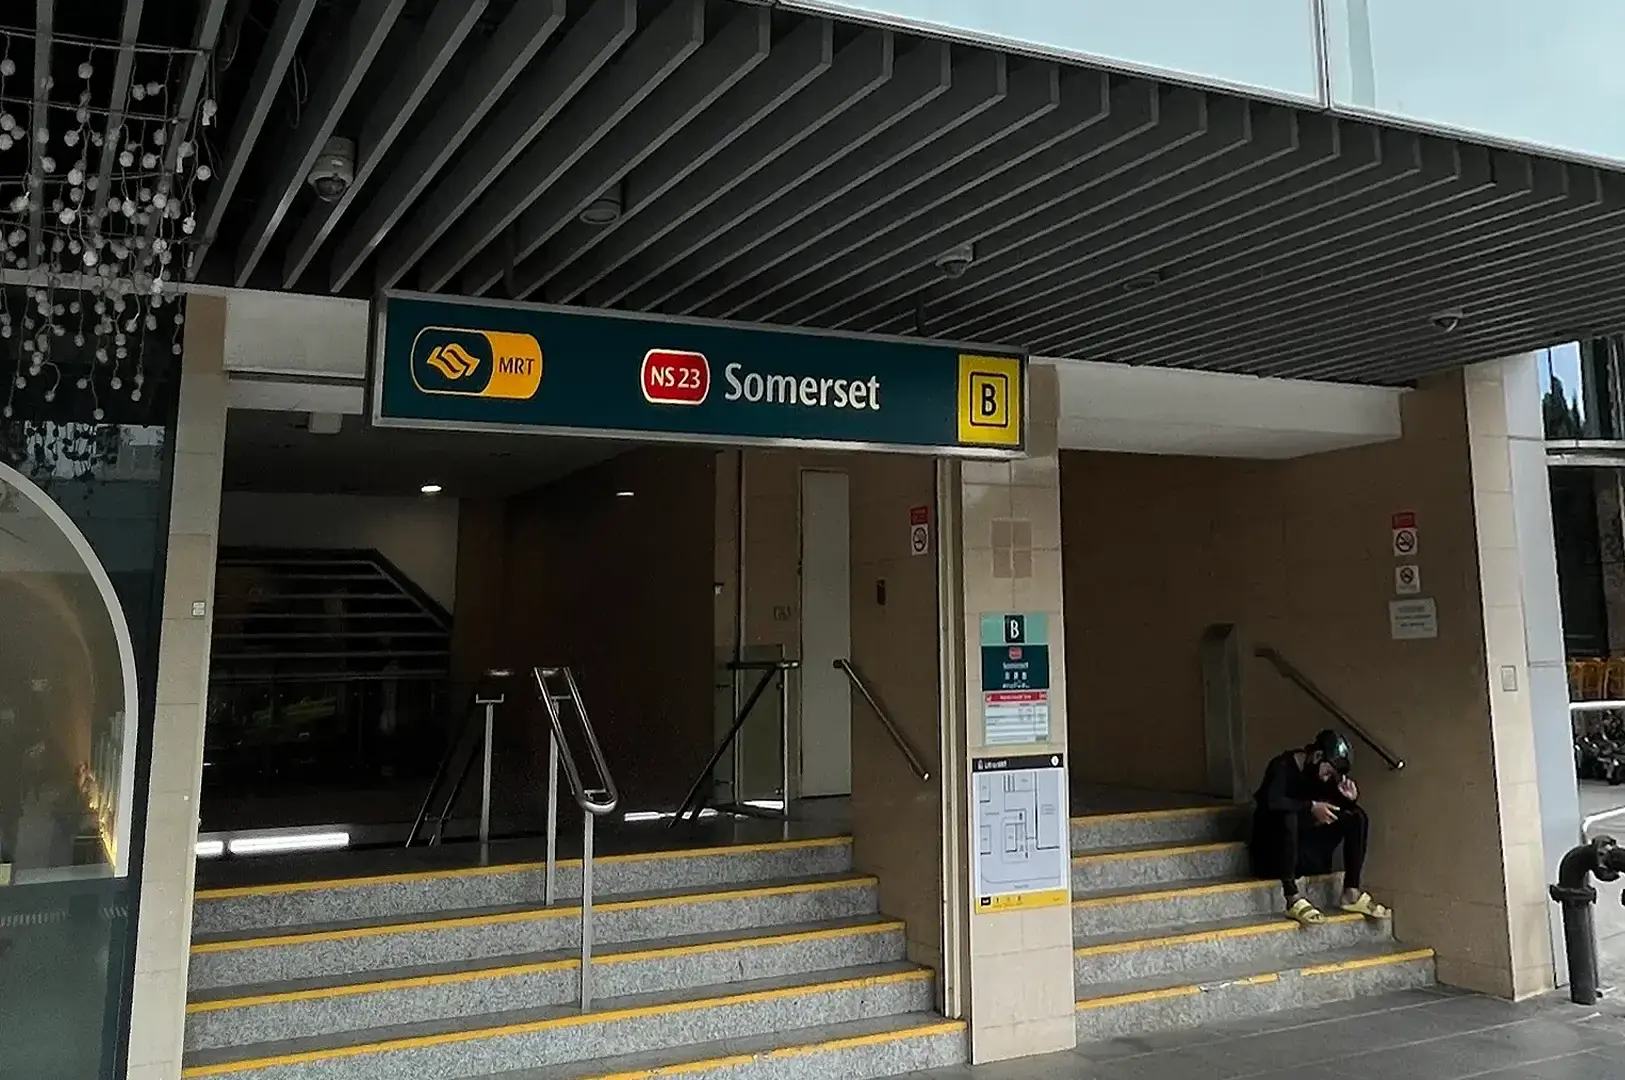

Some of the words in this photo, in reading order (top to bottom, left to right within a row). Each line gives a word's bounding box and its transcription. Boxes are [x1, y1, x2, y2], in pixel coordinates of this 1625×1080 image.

[499, 357, 535, 375] MRT
[724, 362, 880, 410] Somerset
[982, 383, 997, 417] B
[1010, 619, 1020, 639] B
